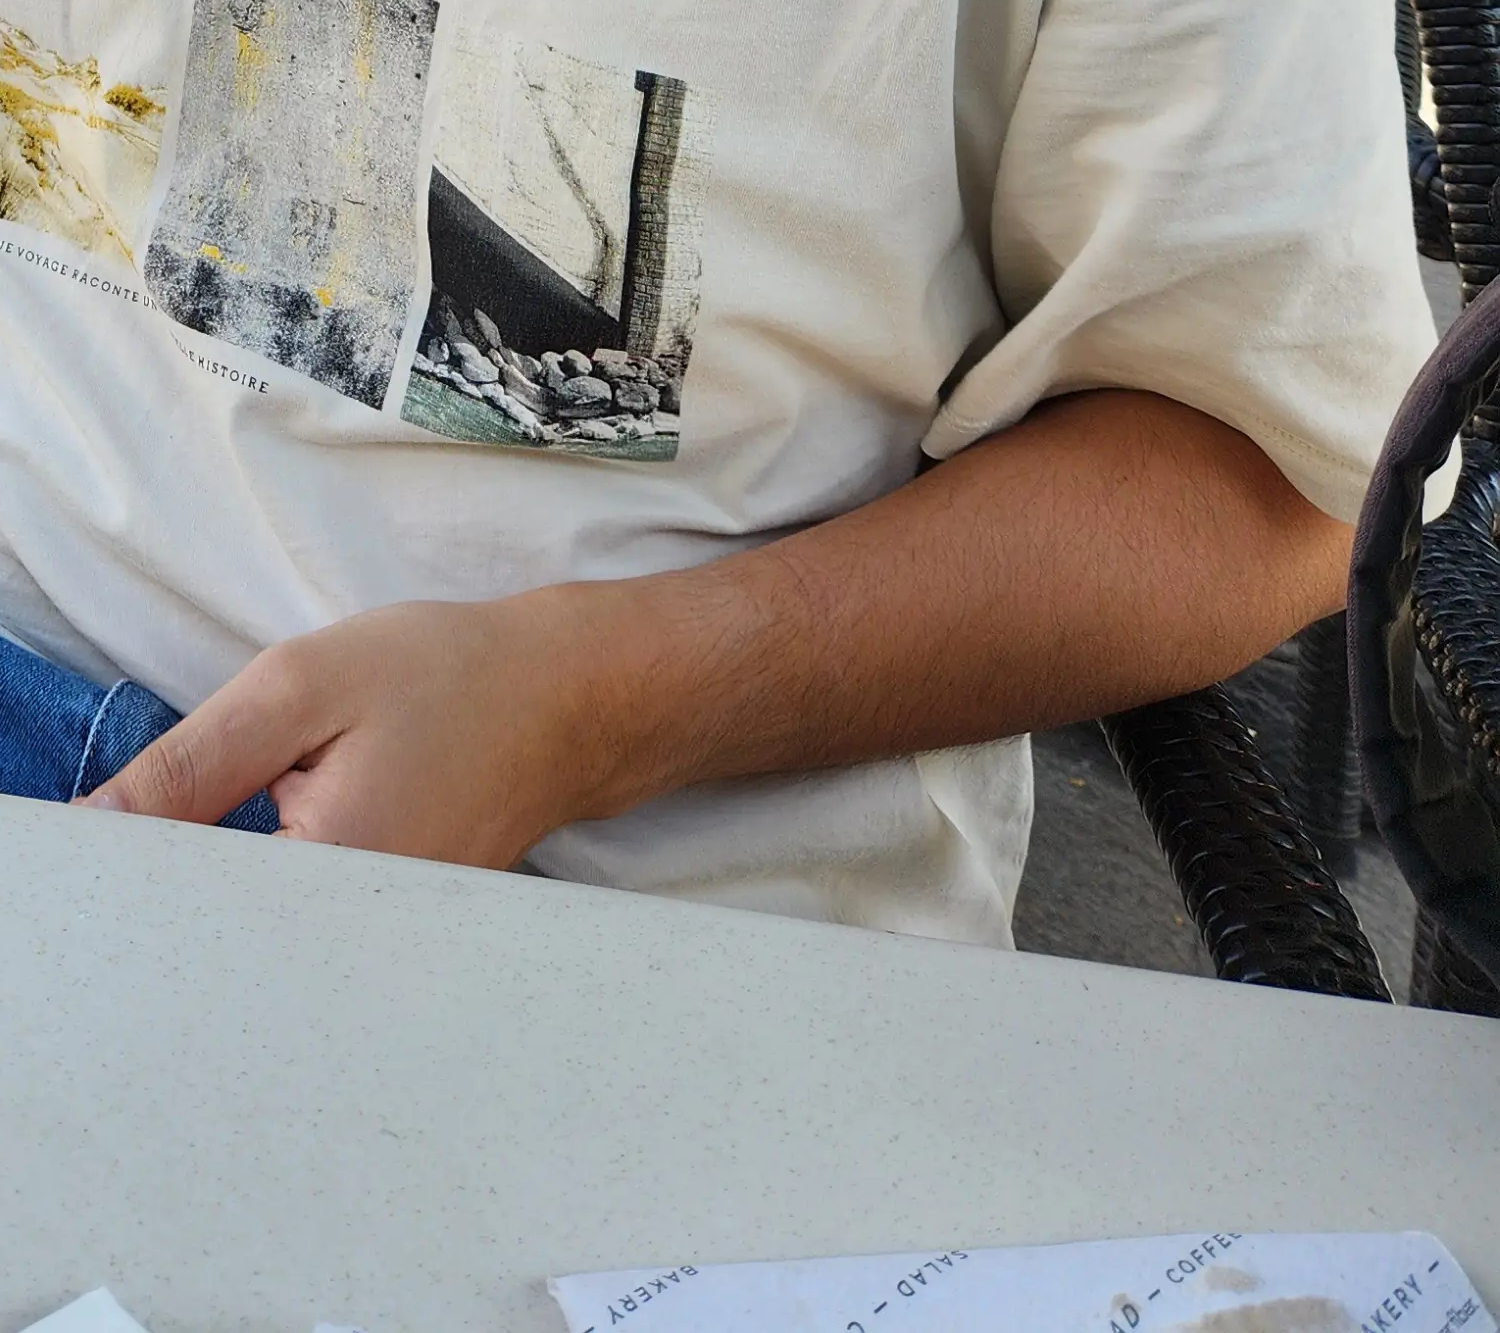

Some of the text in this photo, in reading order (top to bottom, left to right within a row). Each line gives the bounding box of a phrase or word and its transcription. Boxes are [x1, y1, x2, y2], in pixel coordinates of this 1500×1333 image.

[17, 247, 69, 277] VOYAGE
[71, 269, 140, 303] RACONTE
[197, 354, 270, 395] HISTOIRE
[607, 1263, 700, 1326] BAKERY
[895, 1249, 969, 1299] SALAD
